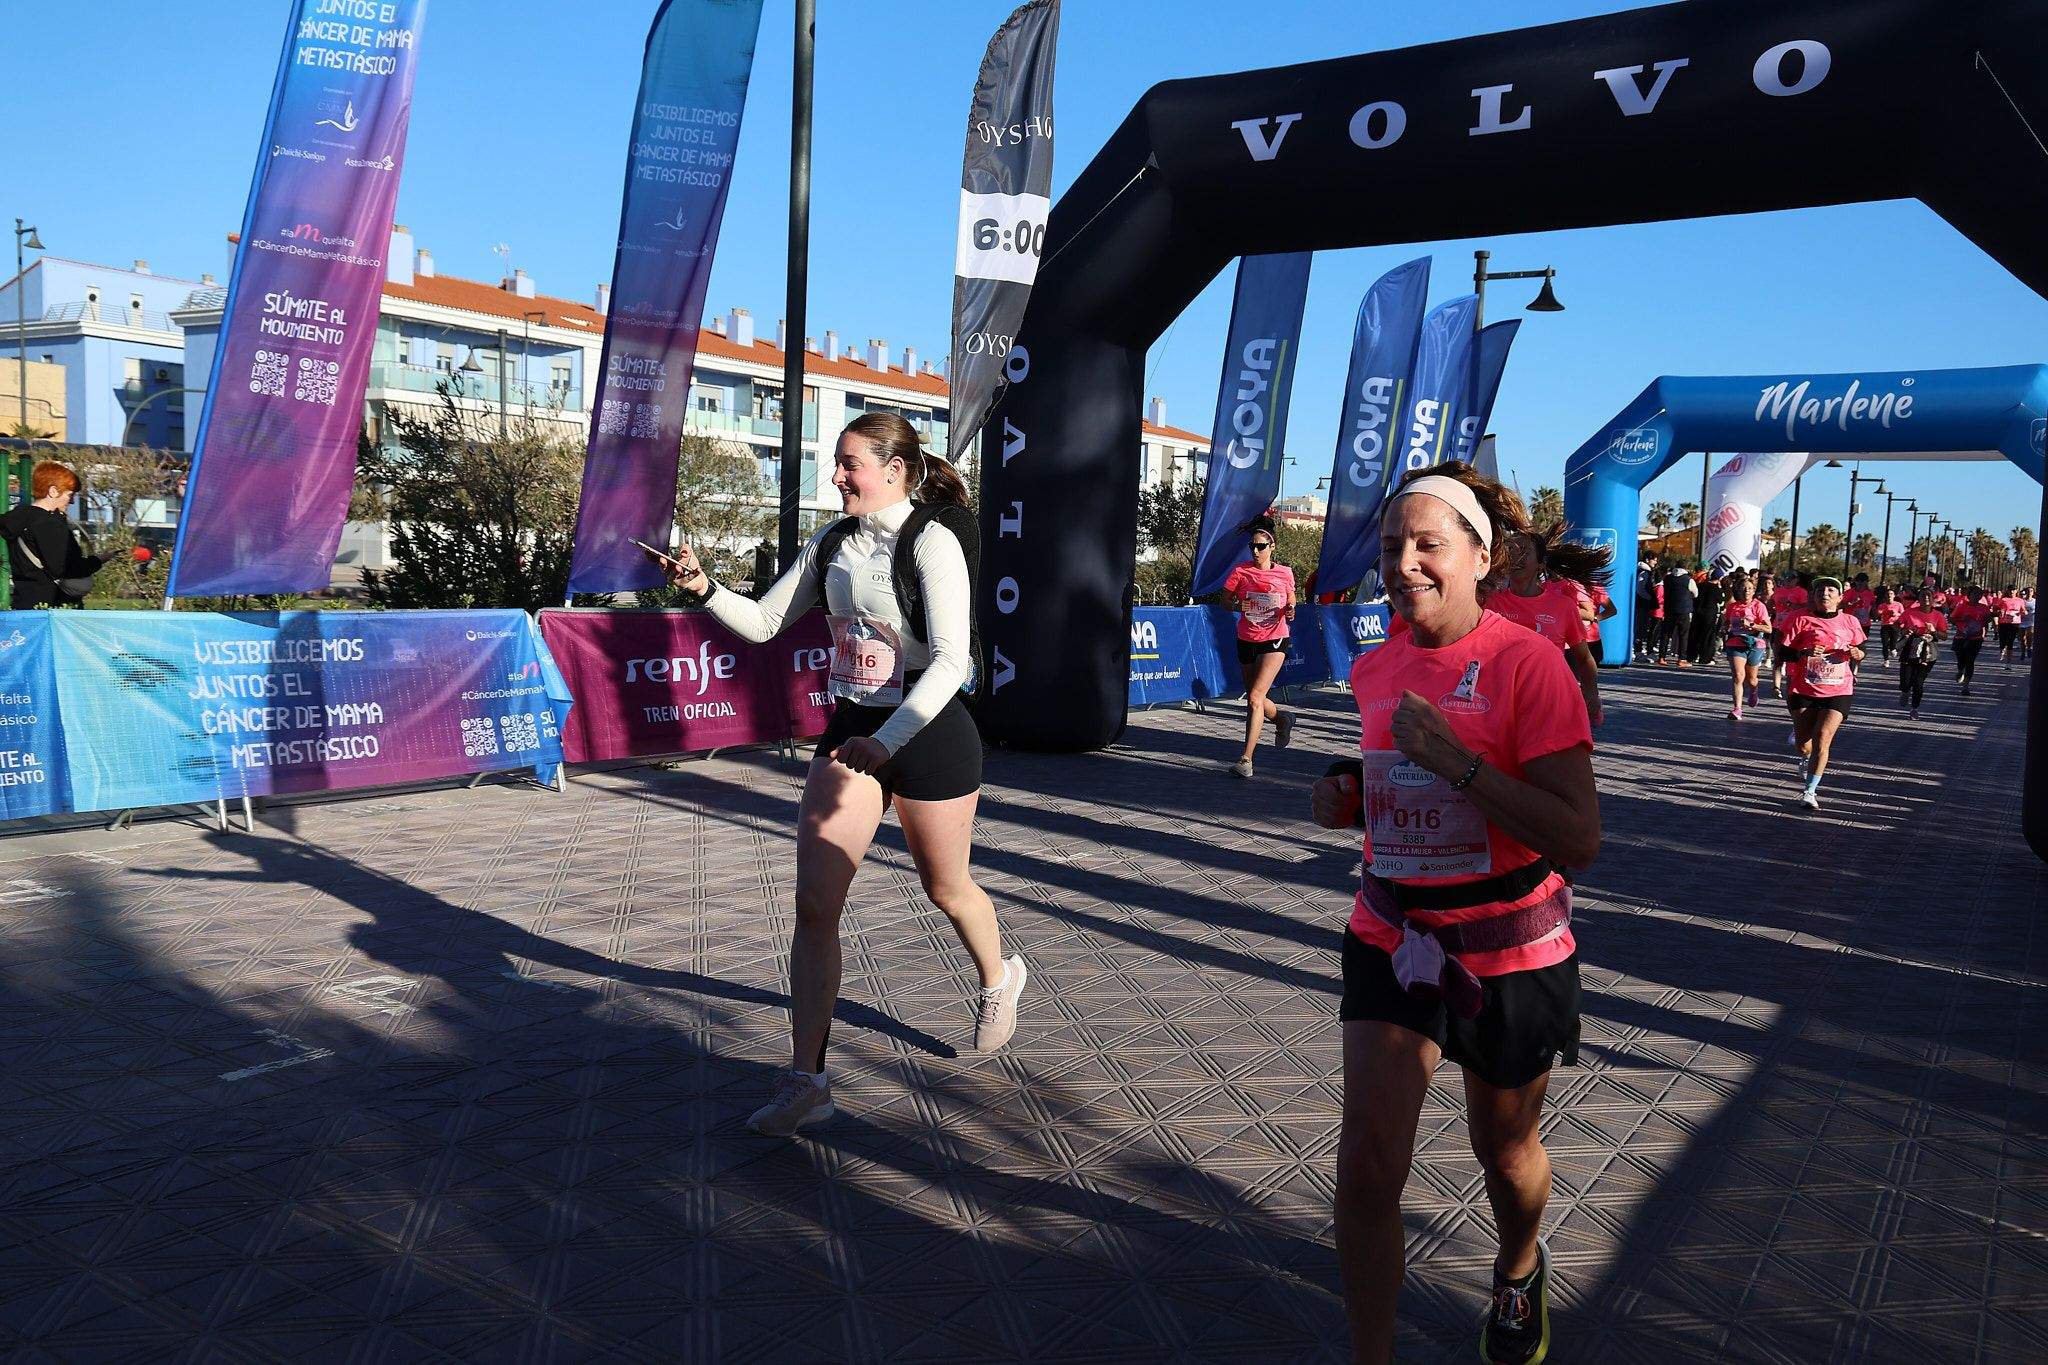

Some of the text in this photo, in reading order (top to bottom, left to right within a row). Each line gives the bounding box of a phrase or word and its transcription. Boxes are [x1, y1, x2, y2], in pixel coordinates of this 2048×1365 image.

[316, 0, 377, 20] JUNTOS
[351, 25, 374, 47] DE
[376, 29, 414, 49] MAMA
[297, 46, 396, 75] METASTÁSICO
[1231, 39, 1832, 162] VOLVO
[642, 103, 738, 127] VISIBILICEMOS
[649, 125, 718, 146] JUNTOS EL
[631, 141, 733, 167] CÁNCER DE MAMA
[635, 164, 721, 188] METASTÁSICO
[263, 289, 347, 326] SÚMATE AL
[260, 317, 345, 346] MOVIMIENTO
[966, 332, 1013, 358] OYS
[609, 353, 668, 376] SÚMATE AL
[606, 374, 665, 392] MOVIMIENTO
[1227, 338, 1276, 469] GOYA
[1350, 376, 1394, 487] GOYA
[992, 345, 1030, 695] VOLVO
[1351, 614, 1385, 639] GOYA
[194, 638, 364, 665] VISIBILICEMOS
[626, 640, 736, 696] renfe
[188, 673, 312, 700] JUNTOS EL
[808, 691, 836, 707] TREN
[201, 701, 384, 734] CÁNCER DE MAMA
[643, 701, 737, 723] TREN OFICIAL
[22, 752, 42, 767] AL
[231, 731, 380, 768] METASTÁSICO
[1391, 768, 1434, 781] ASTURIANA
[1393, 808, 1441, 830] 016
[1402, 834, 1426, 845] 5389
[1430, 860, 1473, 872] Santander
